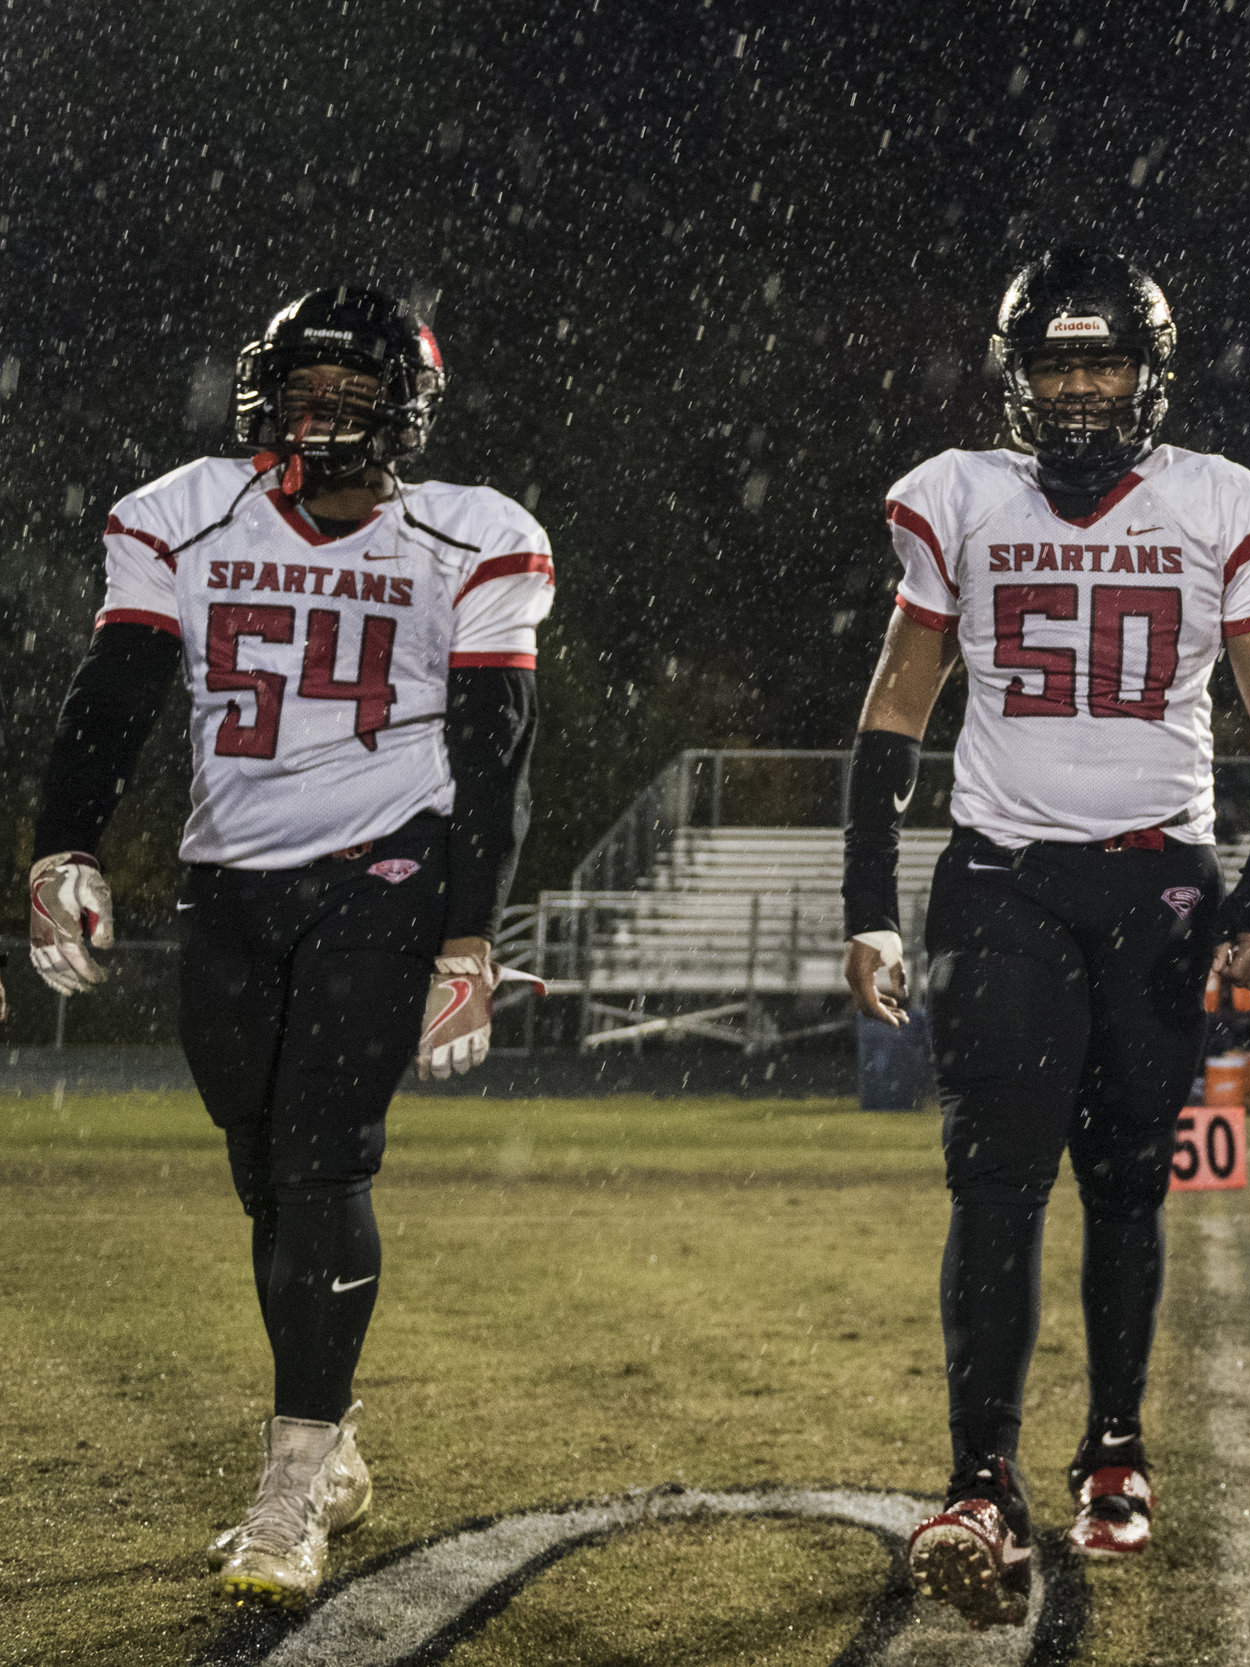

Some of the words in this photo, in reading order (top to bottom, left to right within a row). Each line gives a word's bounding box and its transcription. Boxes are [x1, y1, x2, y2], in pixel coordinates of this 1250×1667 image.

[207, 560, 414, 607] SPARTANS
[988, 542, 1184, 574] SPARTANS
[205, 602, 398, 760] 54
[993, 582, 1183, 721] 50
[1171, 1114, 1235, 1181] 50
